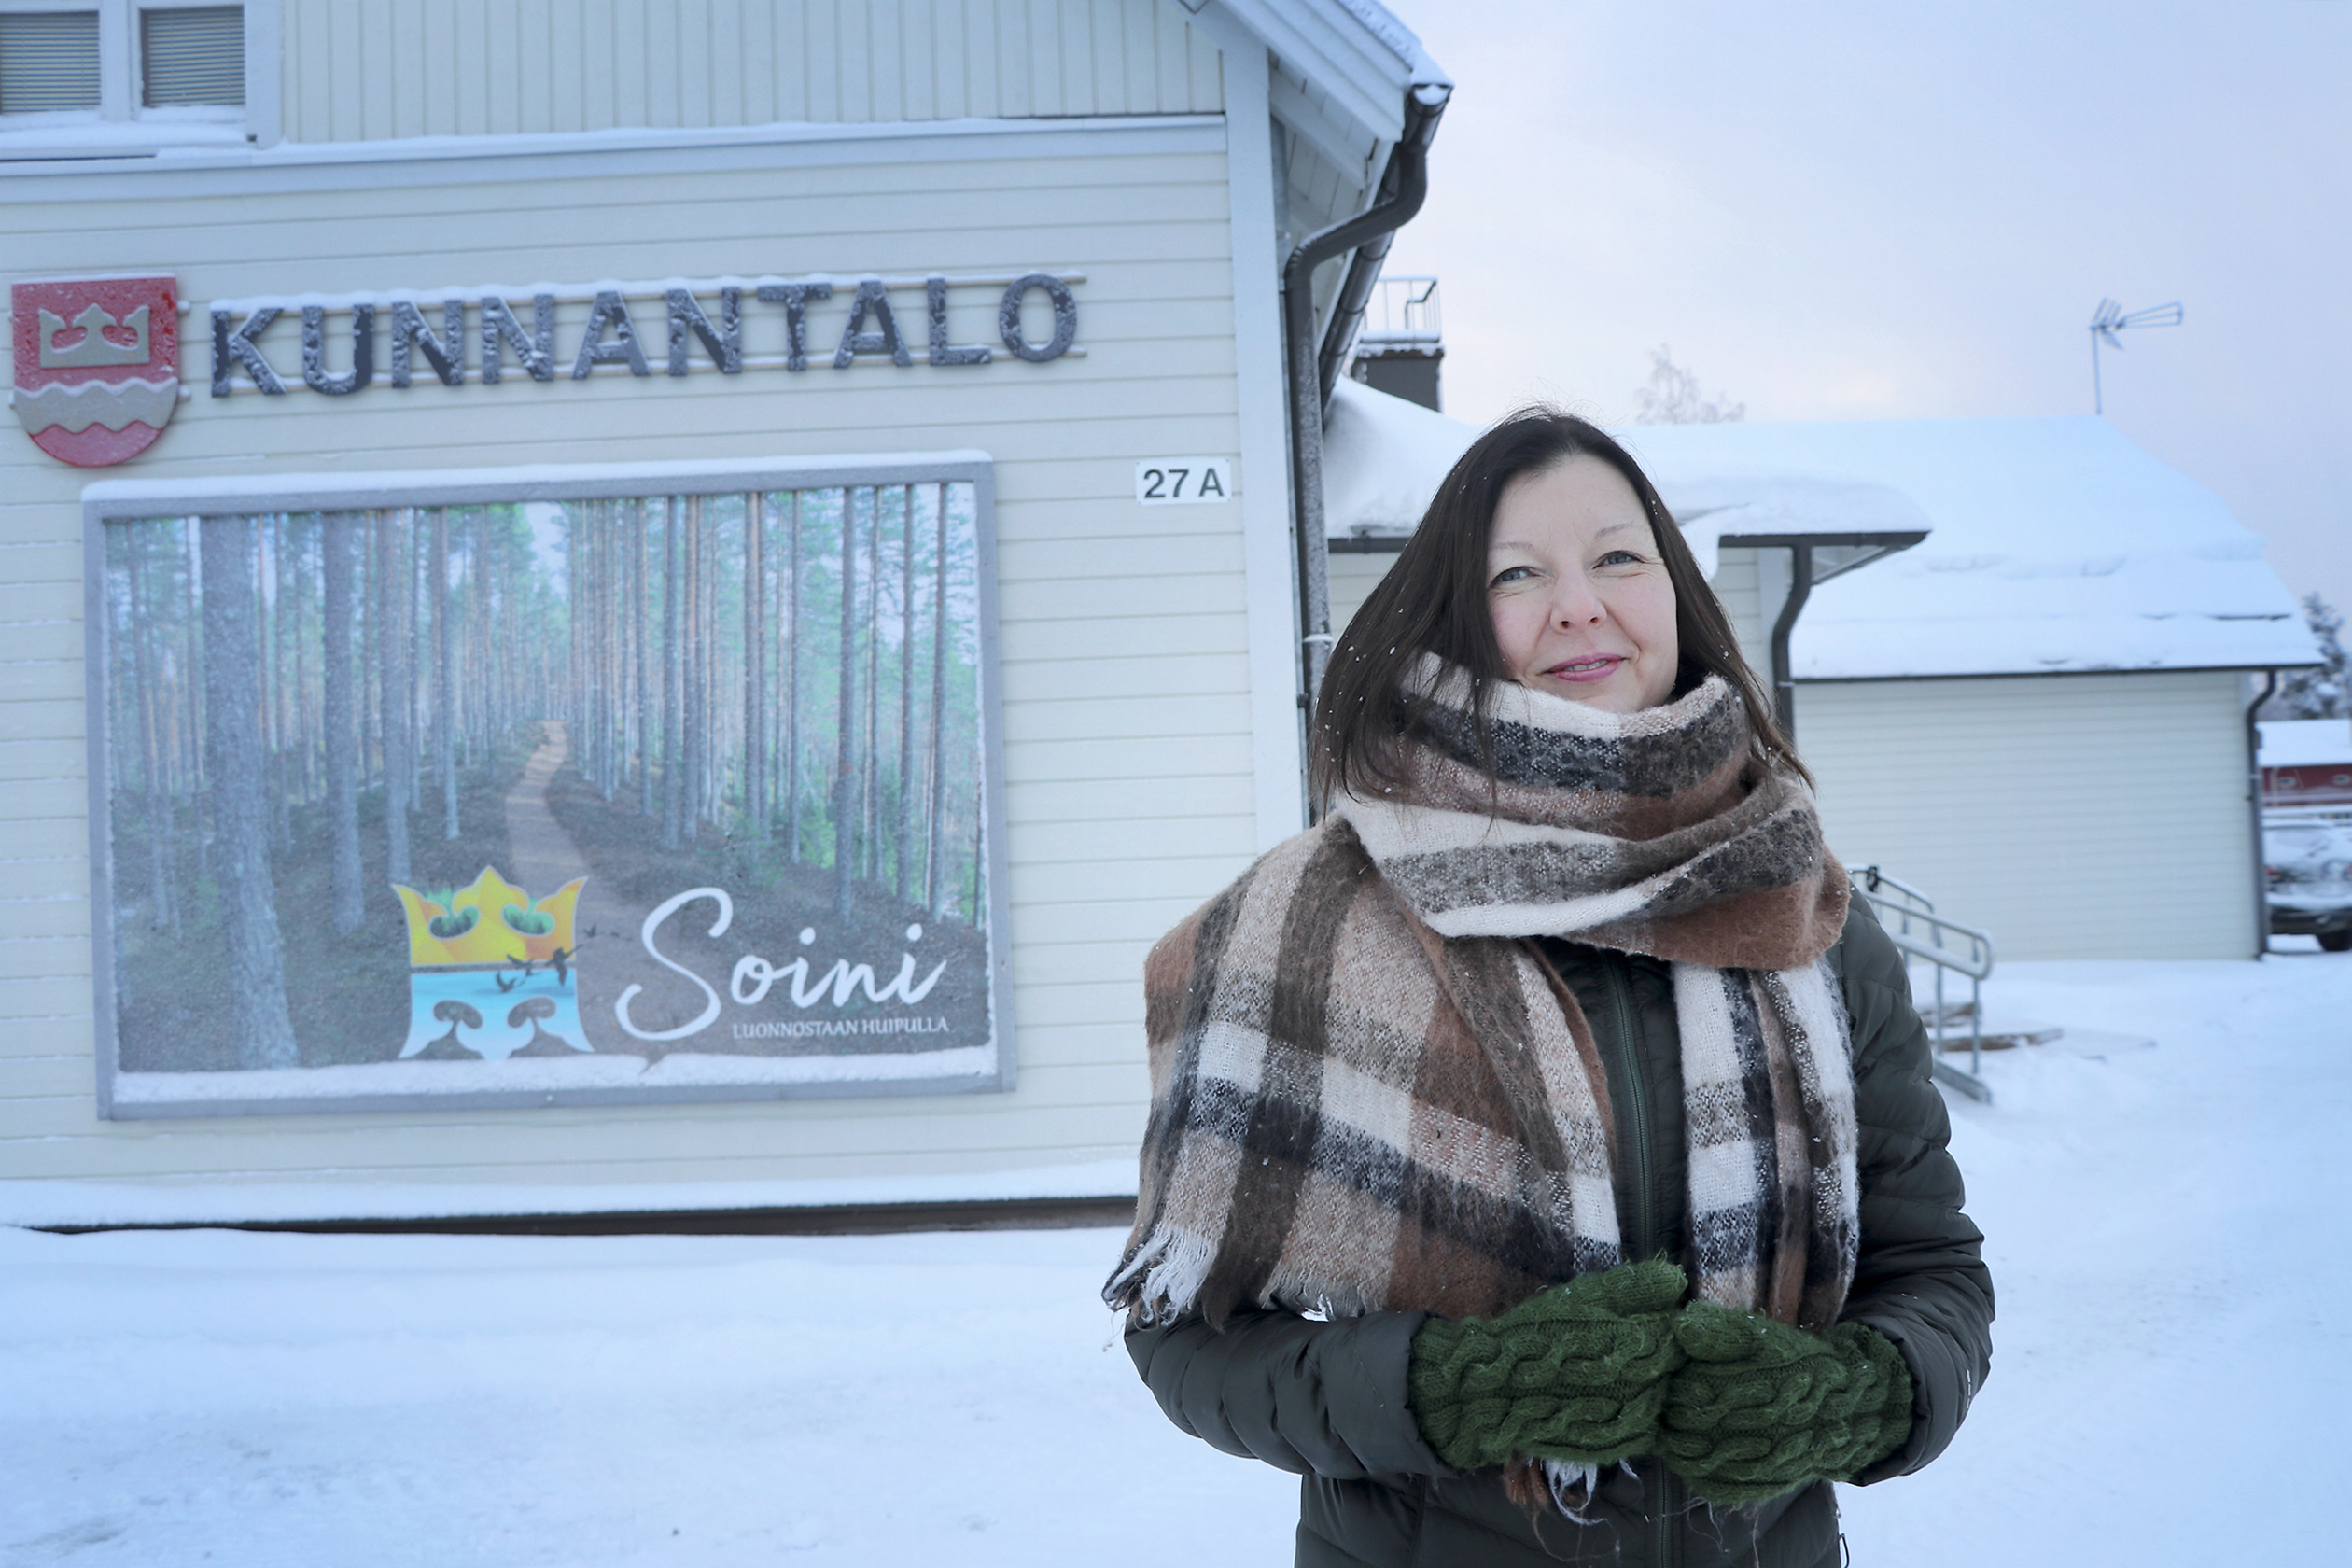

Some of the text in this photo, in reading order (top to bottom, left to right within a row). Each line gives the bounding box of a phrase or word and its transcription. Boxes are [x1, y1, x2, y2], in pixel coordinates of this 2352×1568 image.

[211, 273, 1077, 398] KUNNANTALO
[1143, 468, 1225, 498] 27 A
[614, 887, 947, 1041] Soini
[732, 1016, 950, 1040] LUONNOSTAAN HUIPULLA
